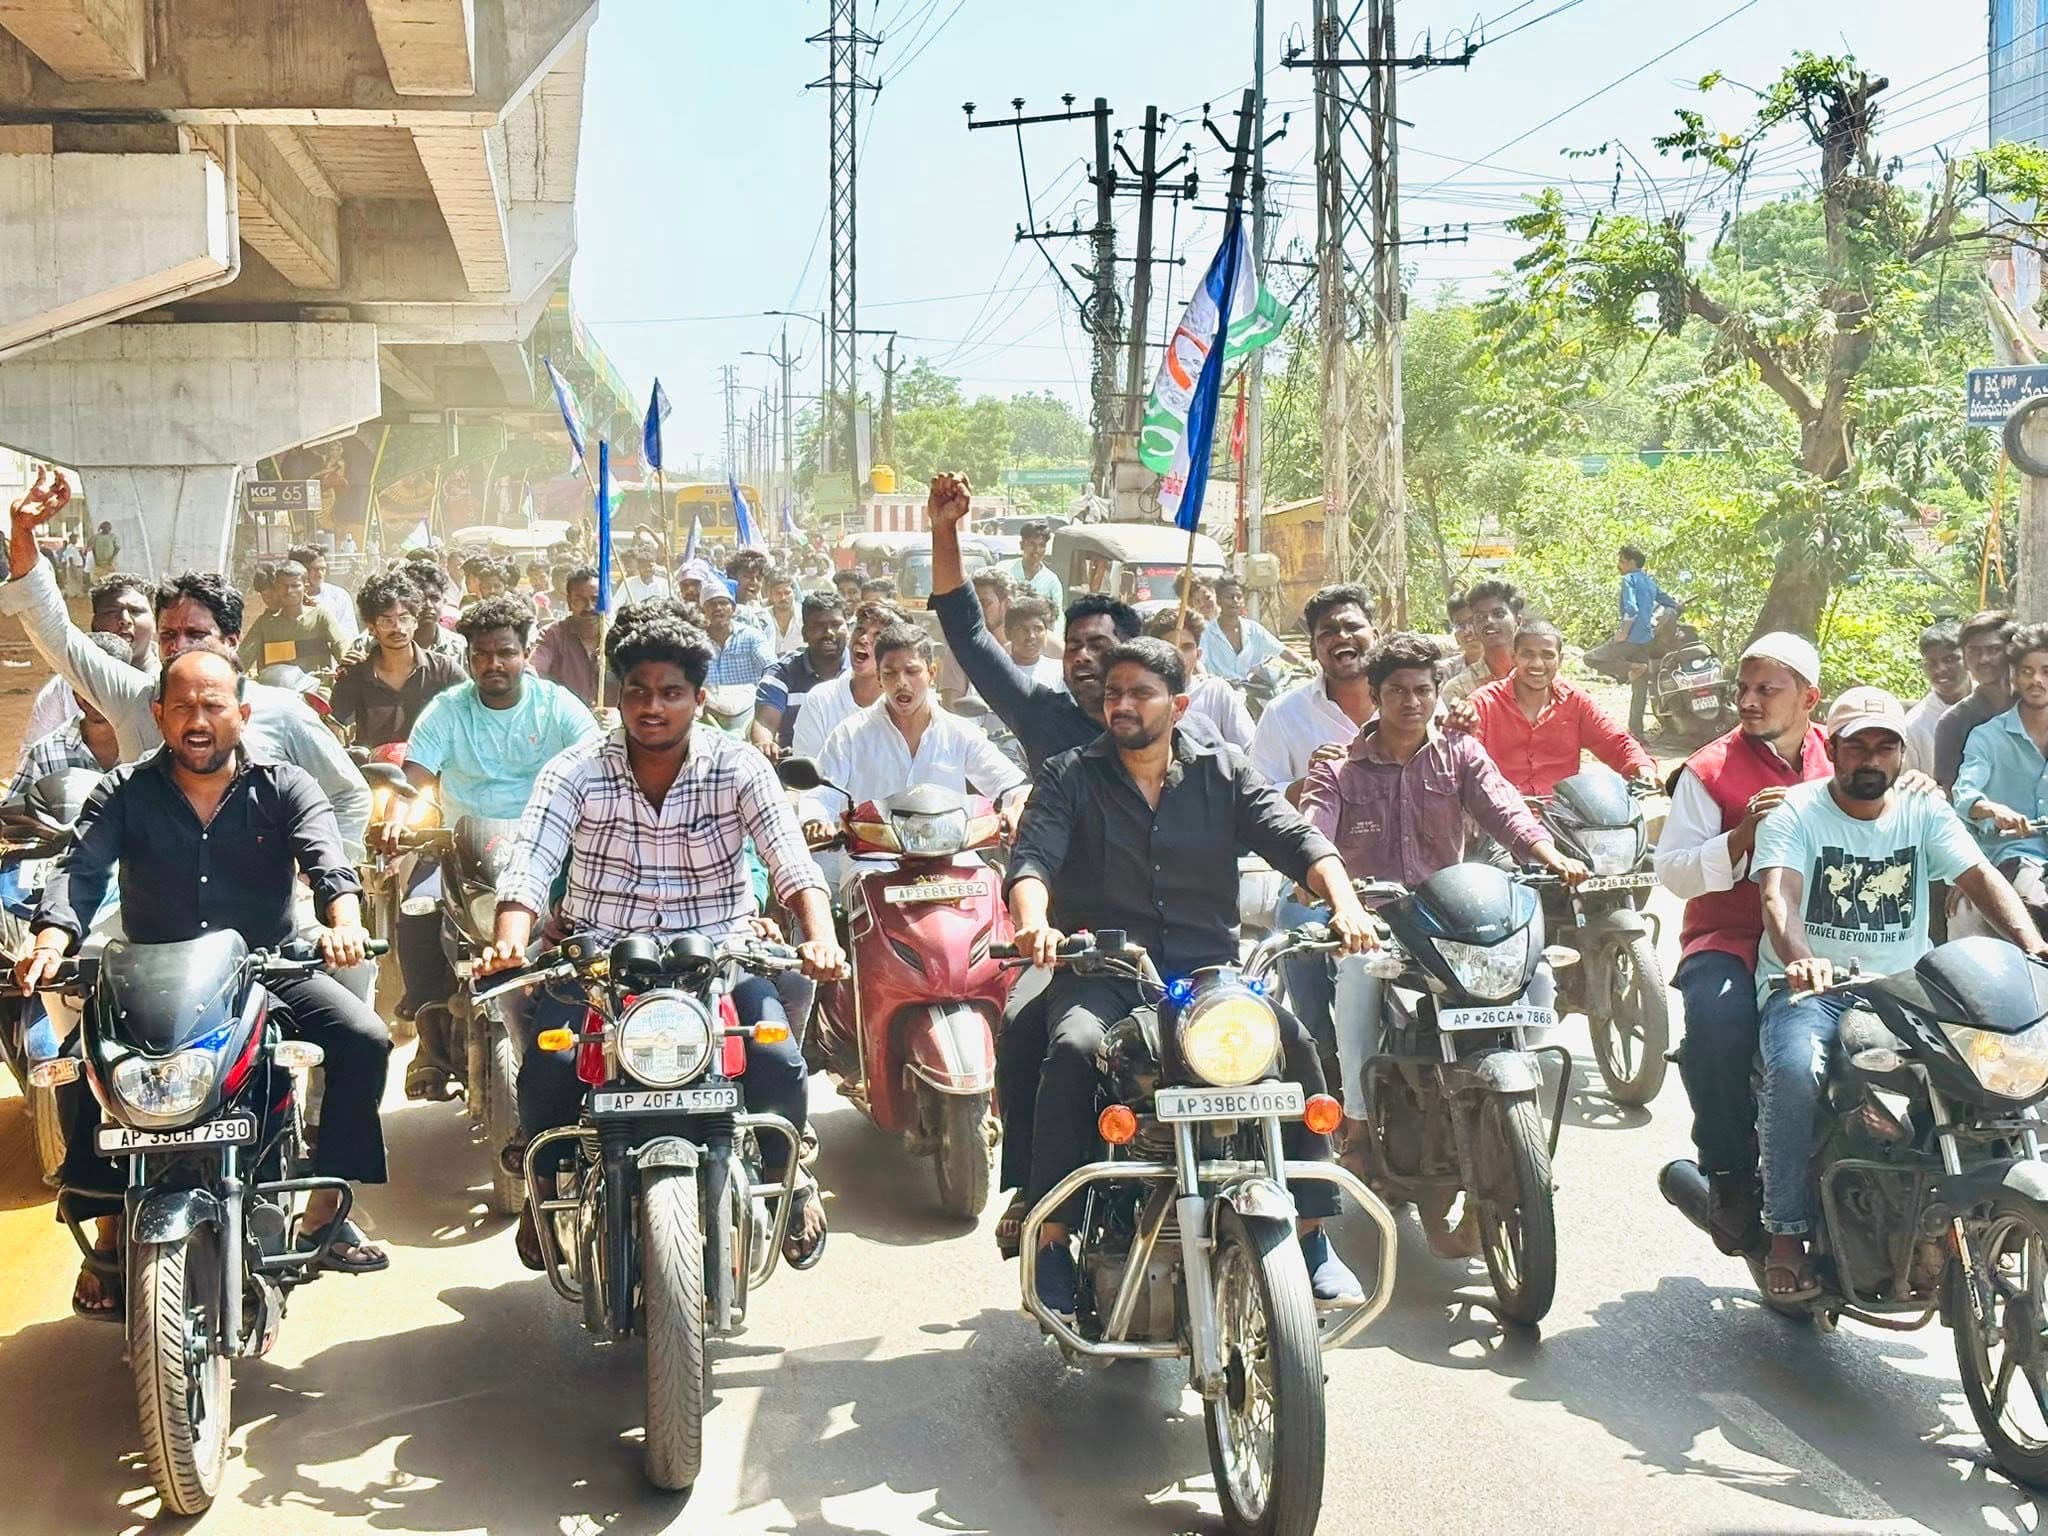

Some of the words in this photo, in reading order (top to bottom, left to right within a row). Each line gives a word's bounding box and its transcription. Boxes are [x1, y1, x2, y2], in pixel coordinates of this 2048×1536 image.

[250, 486, 276, 497] KCP
[282, 486, 302, 500] 65
[1607, 879, 1618, 888] 26
[1804, 923, 1837, 939] TRAVEL
[1839, 930, 1878, 943] BEYOND
[1881, 932, 1897, 943] THE
[1454, 1013, 1470, 1025] AP
[1527, 1011, 1552, 1024] 7868
[614, 1094, 634, 1109] AP
[643, 1092, 684, 1108] 40FA
[692, 1090, 735, 1106] 5503
[121, 1130, 142, 1147] AP
[203, 1121, 248, 1140] 7590
